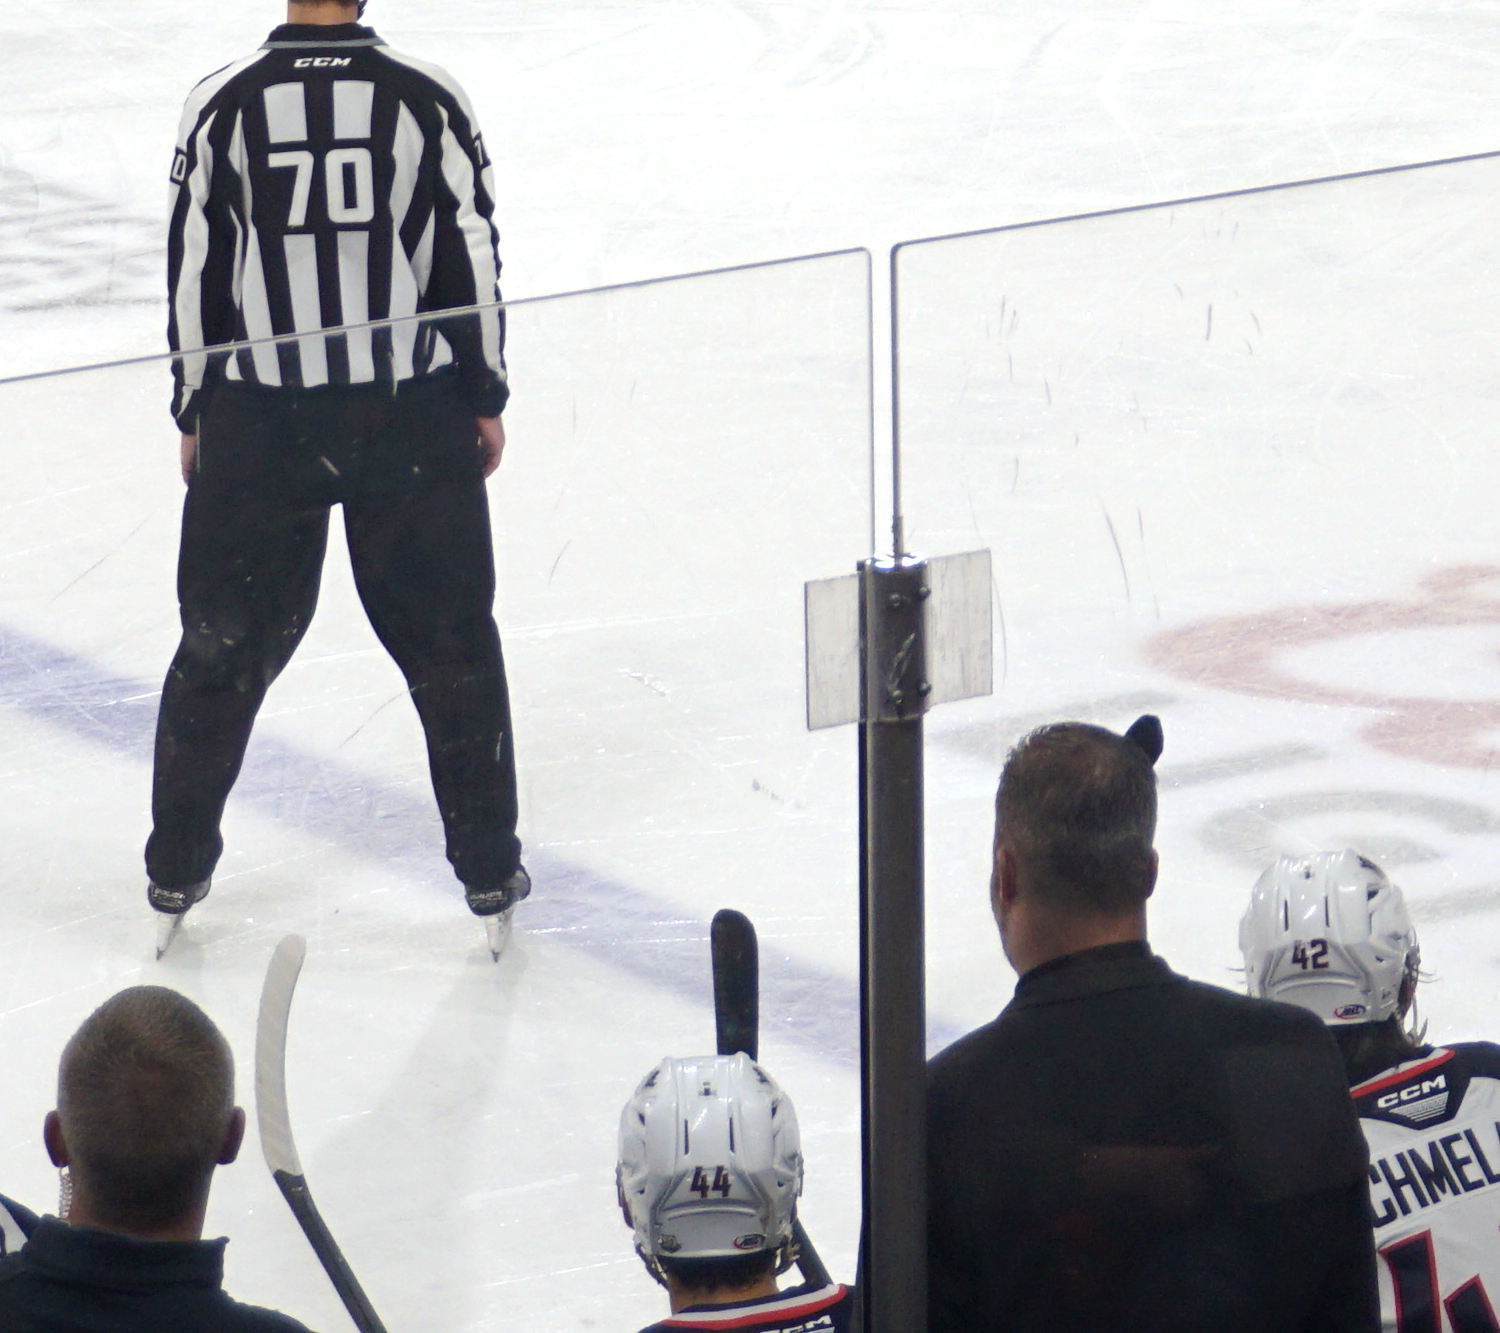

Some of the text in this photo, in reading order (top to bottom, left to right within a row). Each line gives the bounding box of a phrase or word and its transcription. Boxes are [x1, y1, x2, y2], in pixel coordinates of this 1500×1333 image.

[292, 56, 353, 69] CCM
[172, 150, 188, 183] 0
[474, 134, 490, 166] 7
[268, 146, 375, 227] 70
[1291, 938, 1331, 971] 42
[1377, 1074, 1448, 1109] CCM
[690, 1164, 733, 1199] 44
